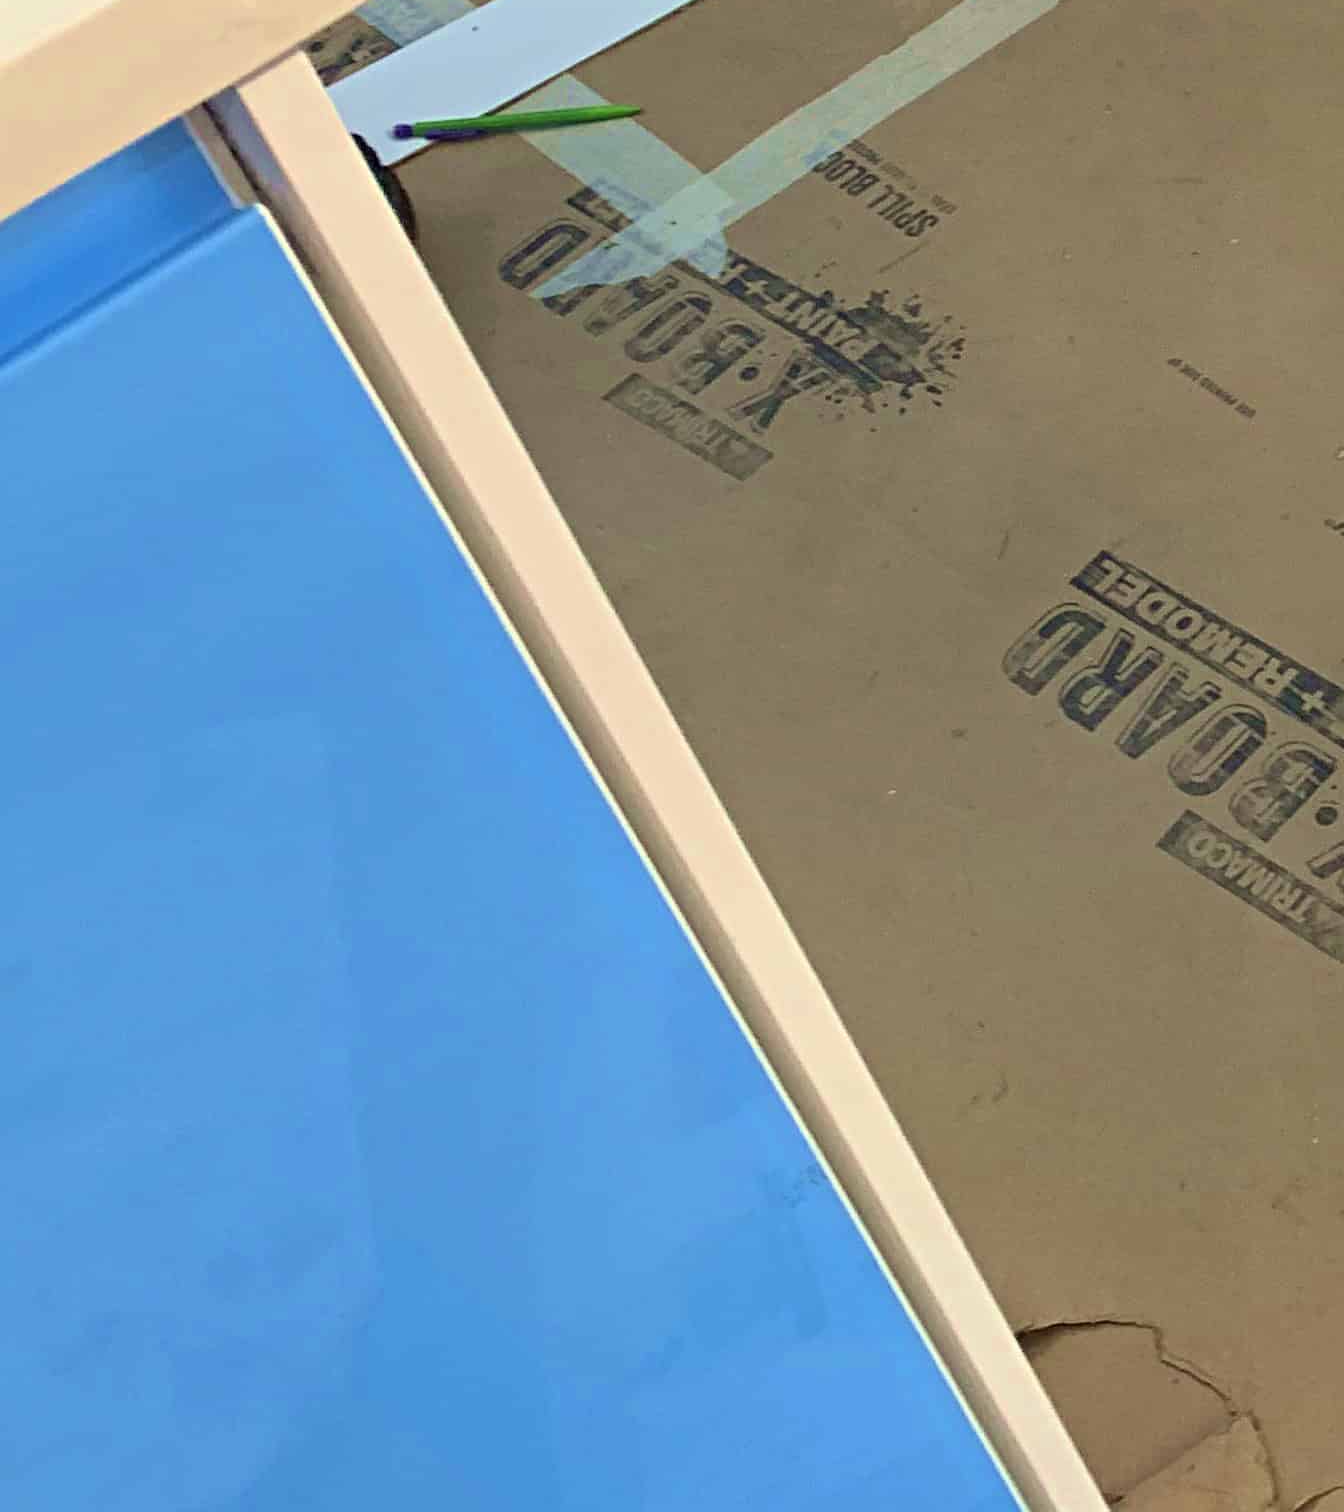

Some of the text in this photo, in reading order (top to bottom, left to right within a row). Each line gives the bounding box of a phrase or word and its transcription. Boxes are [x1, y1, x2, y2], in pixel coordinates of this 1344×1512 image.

[804, 148, 880, 196] BLOC
[867, 184, 939, 238] SPILL
[766, 291, 884, 365] PAINT
[1094, 558, 1298, 696] REMODEL
[1187, 833, 1314, 925] TRIMACO
